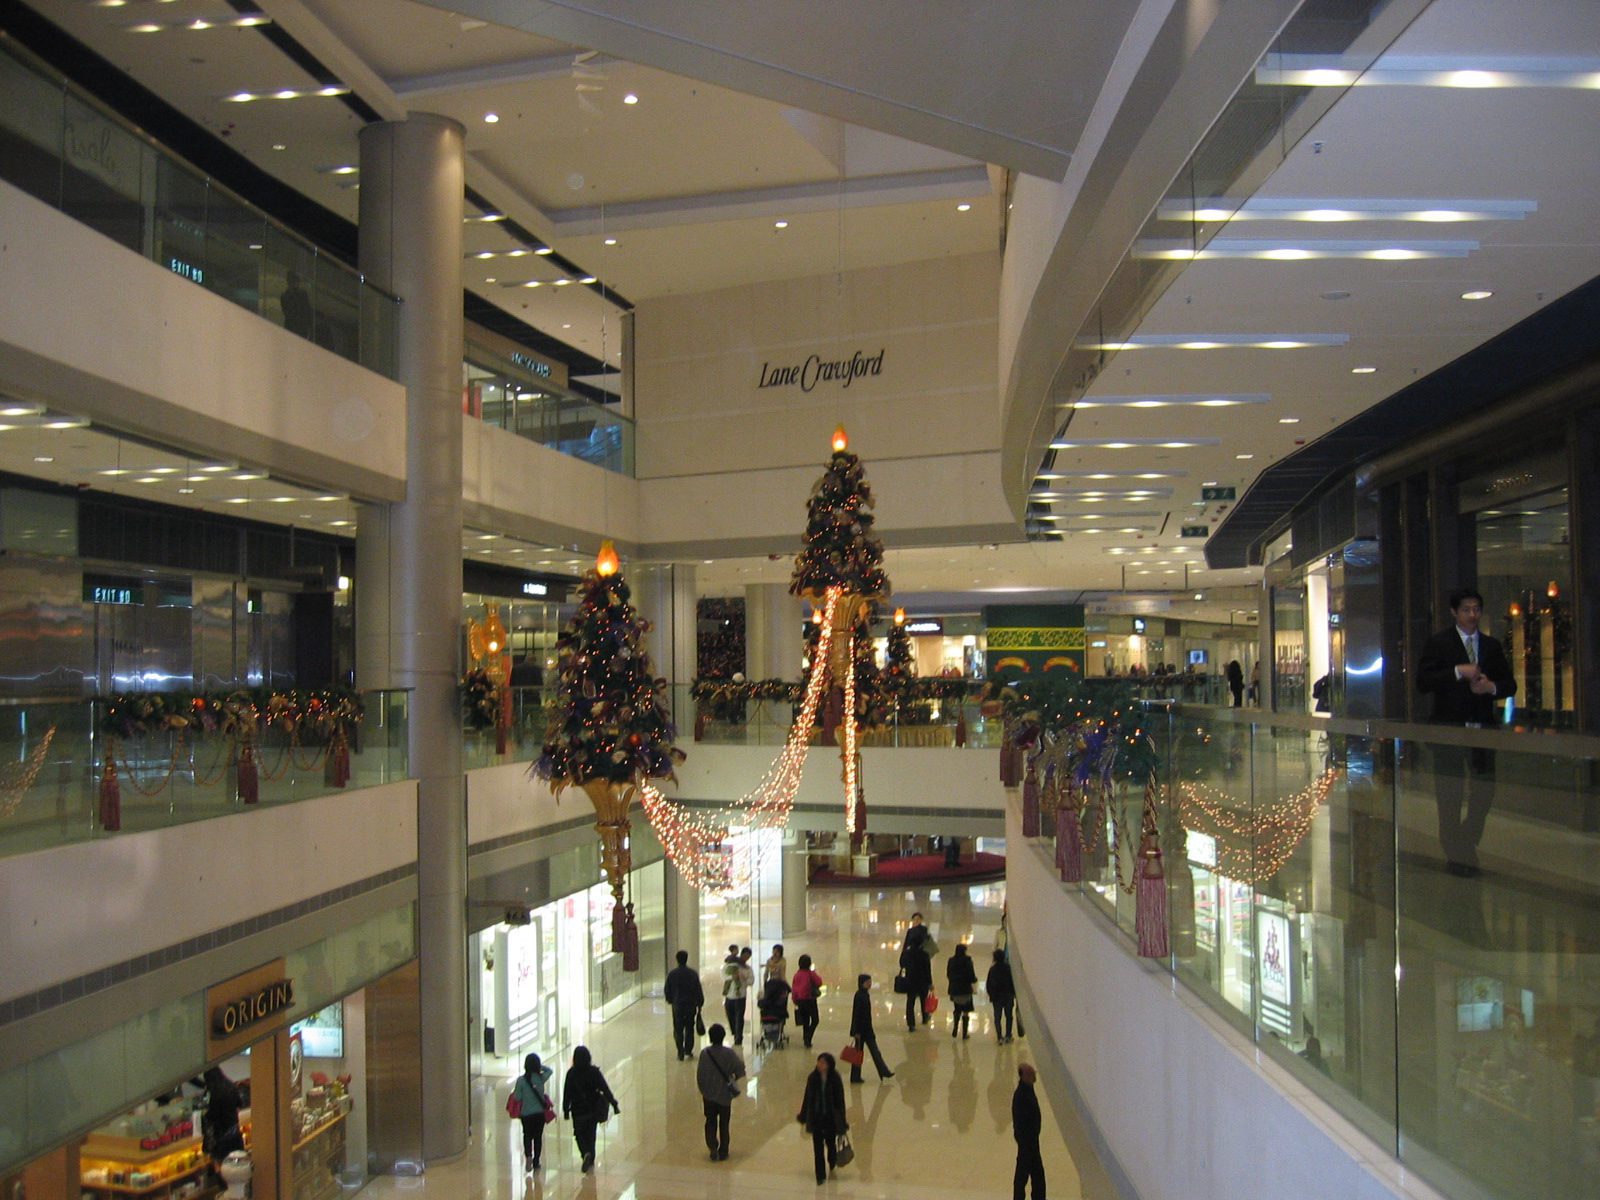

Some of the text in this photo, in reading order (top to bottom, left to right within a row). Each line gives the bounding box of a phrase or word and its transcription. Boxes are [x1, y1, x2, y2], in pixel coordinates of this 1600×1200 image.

[171, 258, 190, 277] EXIT
[759, 349, 884, 392] Lane Crawford
[95, 587, 116, 602] EXIT
